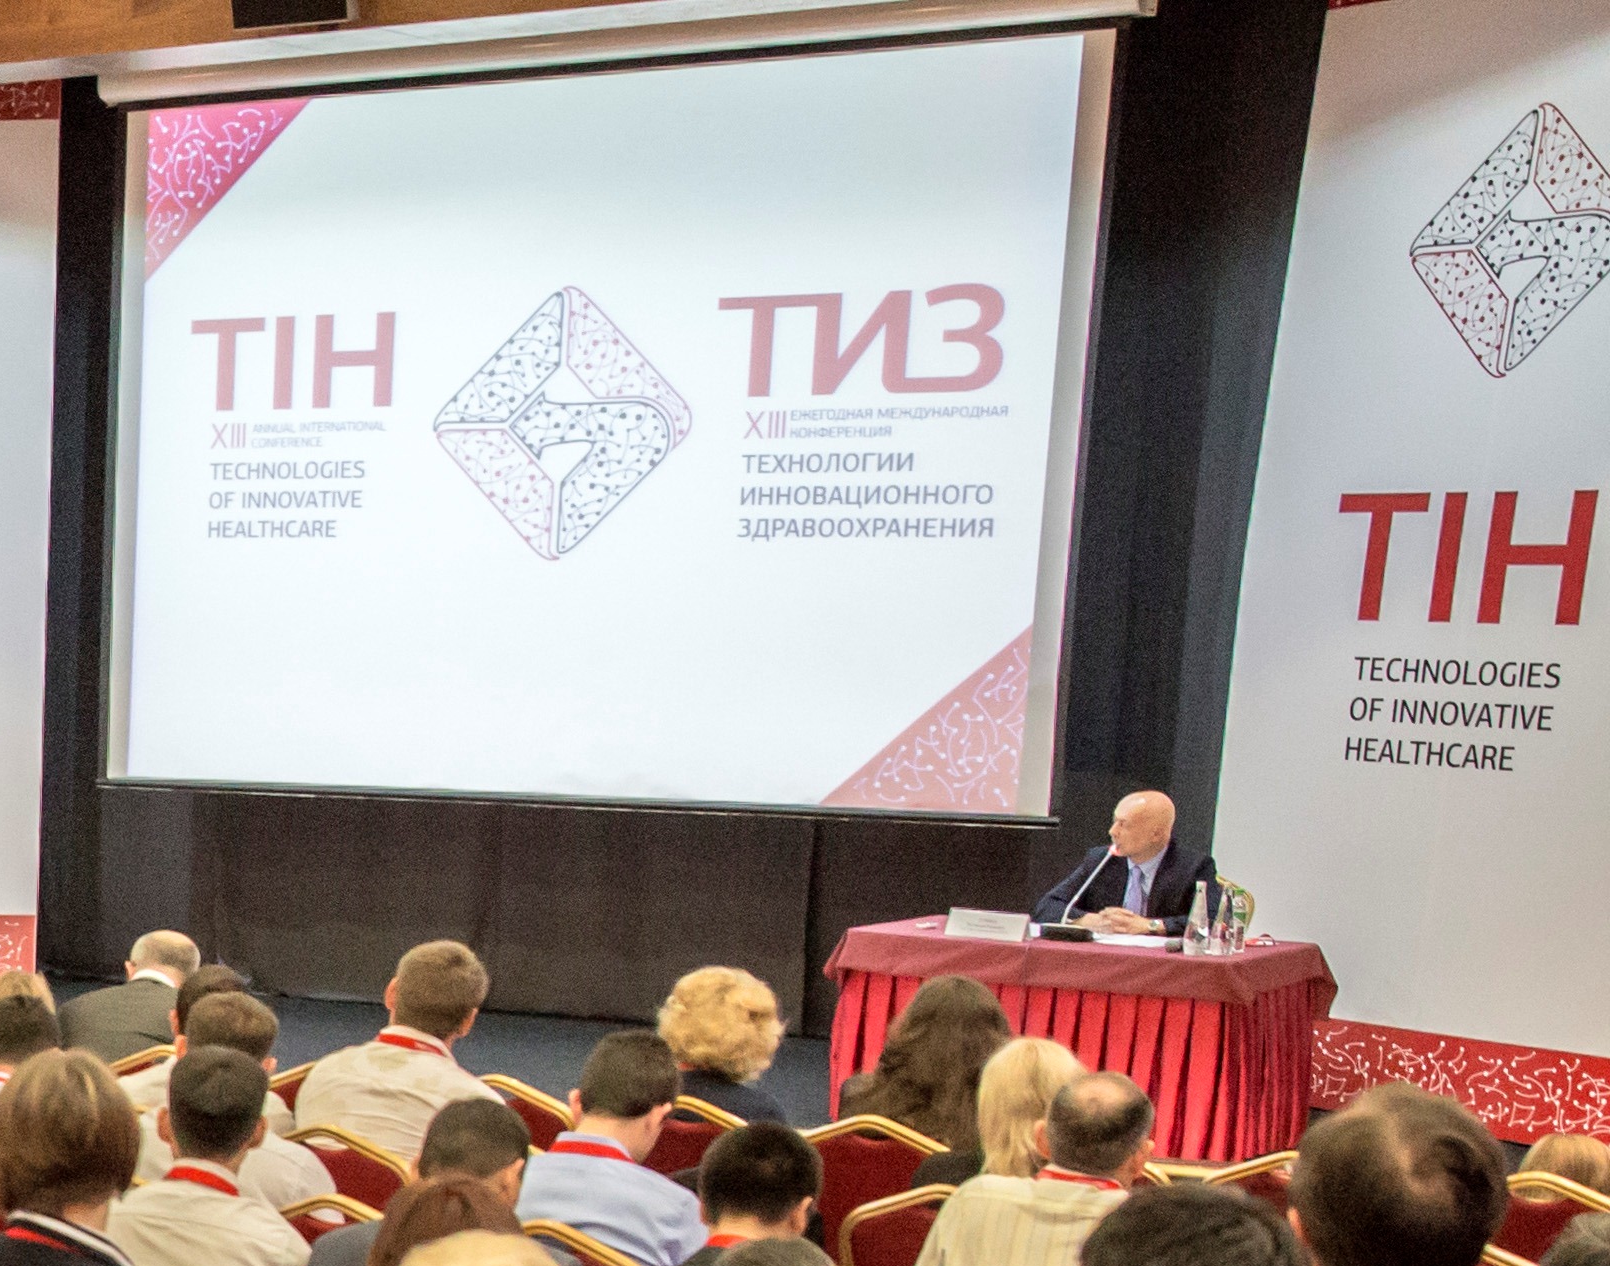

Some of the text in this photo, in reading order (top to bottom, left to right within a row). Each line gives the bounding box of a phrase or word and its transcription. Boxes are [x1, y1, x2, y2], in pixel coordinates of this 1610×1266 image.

[718, 283, 1006, 398] ТИЗ
[191, 311, 396, 411] TIH
[743, 410, 786, 440] XIII
[791, 405, 1010, 422] ЕЖЕГОДНАЯ МЕЖДУНАРОДНАЯ
[211, 423, 247, 449] XIII
[252, 420, 387, 434] ANNUAL INTERNATIONAL
[790, 426, 893, 439] КОНФЕРЕНЦИЯ
[251, 436, 324, 449] CONFERENCE
[210, 460, 366, 481] TECHNOLOGIES
[741, 452, 915, 474] ТЕХНОЛОГИИ
[209, 489, 363, 510] OF INNOVATIVE
[740, 484, 995, 509] ИННОВАЦИОННОГО
[207, 519, 338, 539] HEALTHCARE
[737, 517, 995, 542] ЗДРАВООХРАНЕНИЯ
[1339, 489, 1599, 625] TIH
[1354, 656, 1561, 689] TECHNOLOGIES
[1349, 696, 1554, 731] OF INNOVATIVE
[1344, 736, 1516, 772] HEALTHCARE
